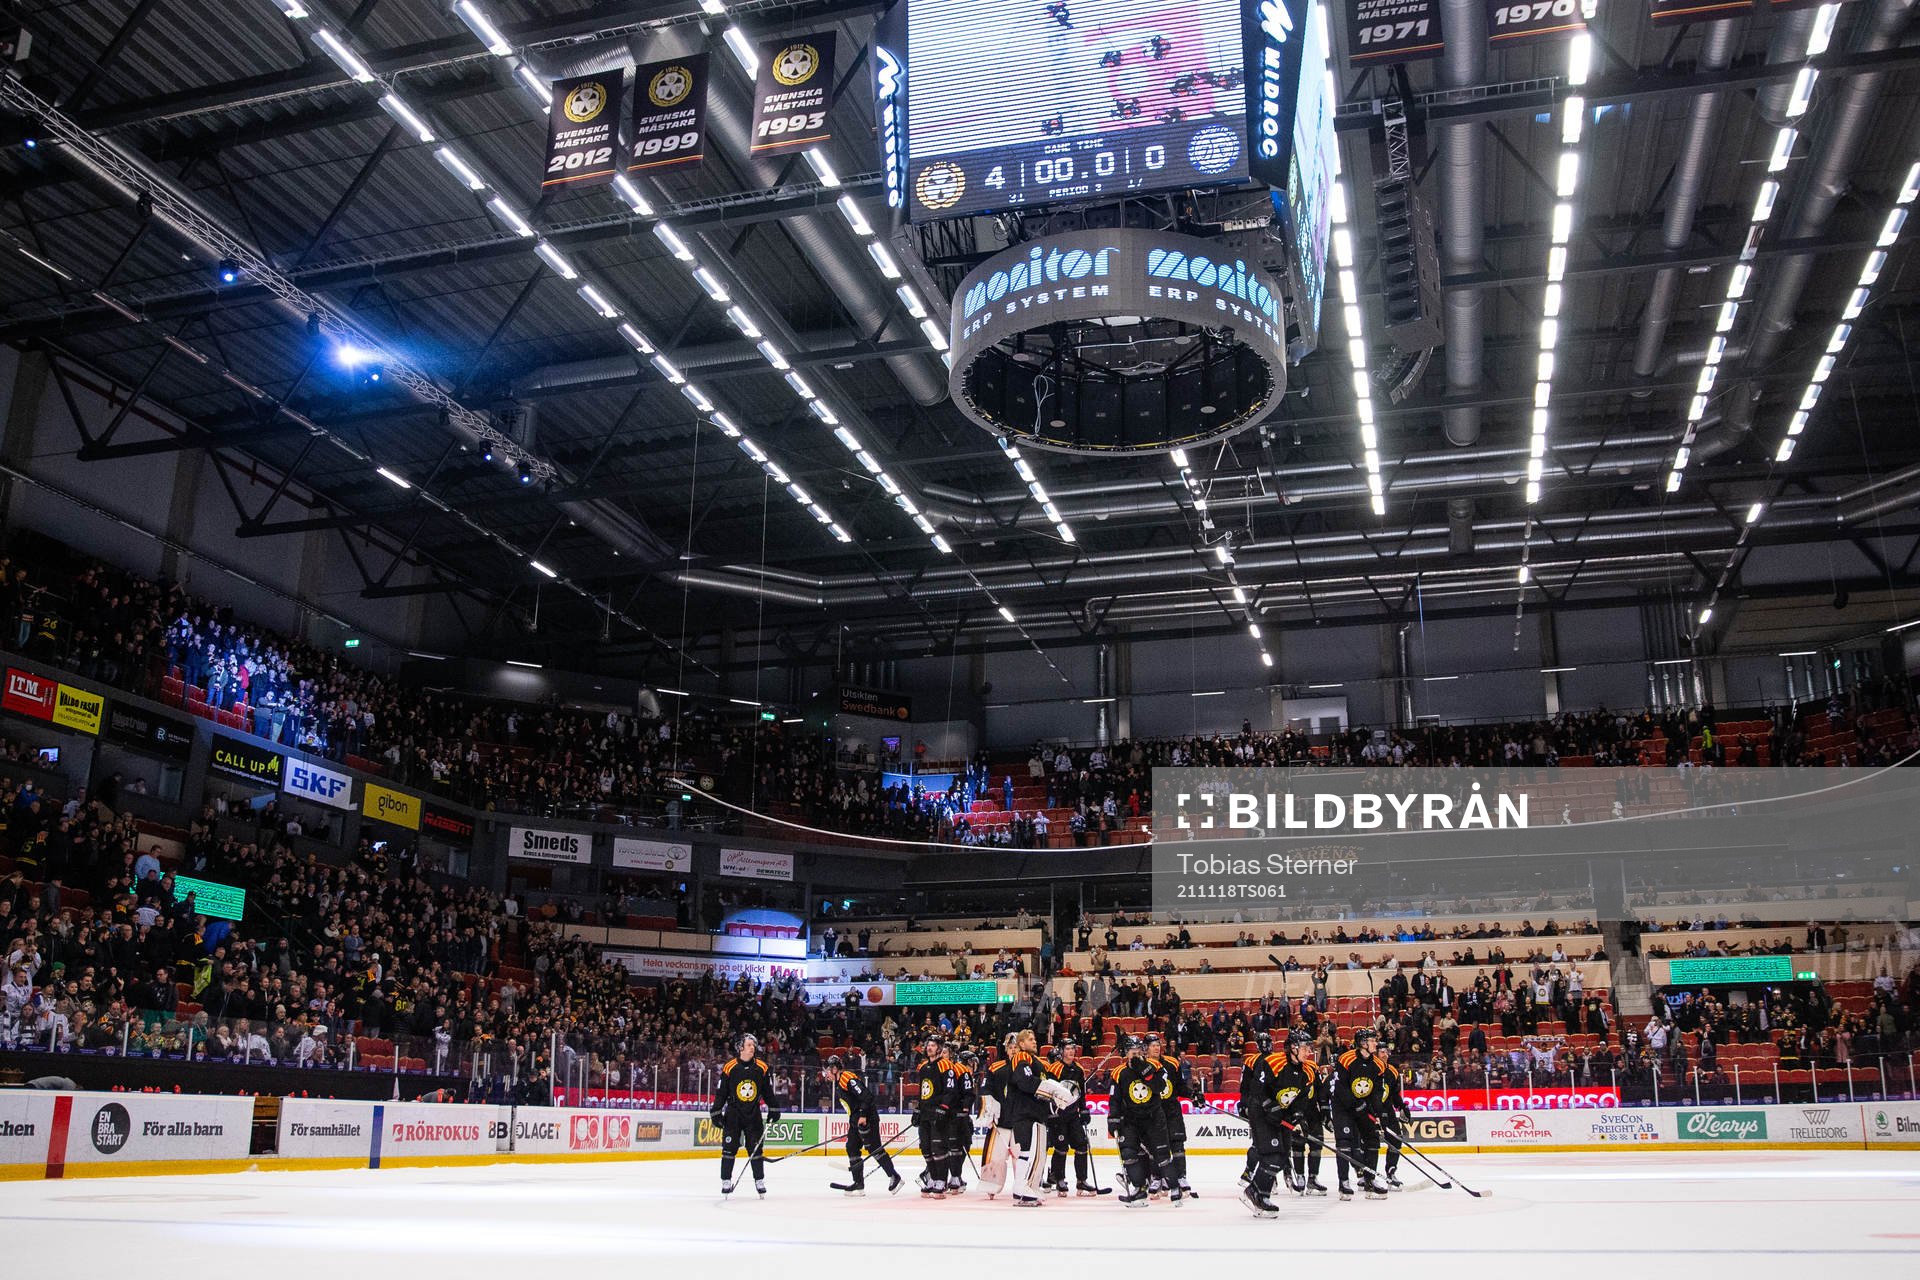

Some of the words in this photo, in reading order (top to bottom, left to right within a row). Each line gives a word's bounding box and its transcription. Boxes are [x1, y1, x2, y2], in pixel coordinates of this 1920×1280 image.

[1495, 0, 1575, 25] 1970
[1359, 19, 1430, 44] 1971
[764, 88, 823, 104] SVENSKA
[1262, 46, 1281, 158] MIDROC
[640, 108, 696, 125] SVENSKA
[758, 111, 826, 137] 1993
[555, 124, 609, 141] SVENSKA
[633, 132, 699, 157] 1999
[1044, 143, 1071, 154] GAME
[1076, 138, 1104, 149] TIME
[547, 147, 613, 173] 2012
[984, 165, 1006, 190] 4
[1145, 144, 1165, 170] 0
[1048, 185, 1089, 198] PERIOD
[964, 246, 1120, 319] monitor
[1148, 248, 1279, 325] monitor
[1005, 284, 1110, 315] SYSTEM
[1149, 285, 1199, 302] ERP
[1215, 298, 1281, 346] SYSTEM
[842, 688, 879, 702] Utsikten
[841, 700, 896, 717] Swedbank
[215, 749, 246, 769] CALL
[250, 760, 266, 774] UP
[291, 767, 346, 798] SKF
[378, 794, 408, 816] gibon
[524, 830, 579, 854] Smeds
[1291, 848, 1360, 860] ARENA
[643, 958, 663, 969] Hela
[664, 959, 700, 970] veckans
[99, 1111, 111, 1123] EN
[1687, 1112, 1758, 1138] O'Learys
[98, 1123, 115, 1134] BRA
[143, 1121, 166, 1136] För
[167, 1121, 192, 1136] alla
[194, 1121, 223, 1136] barn
[290, 1123, 308, 1136] För
[310, 1123, 360, 1136] samhället
[406, 1121, 479, 1141] RÖRFOKUS
[765, 1123, 803, 1141] ESSVE
[1491, 1130, 1552, 1138] PROLYMPIA
[1638, 1124, 1654, 1133] AB
[1790, 1127, 1847, 1139] TRELLEBORG
[96, 1134, 124, 1146] START
